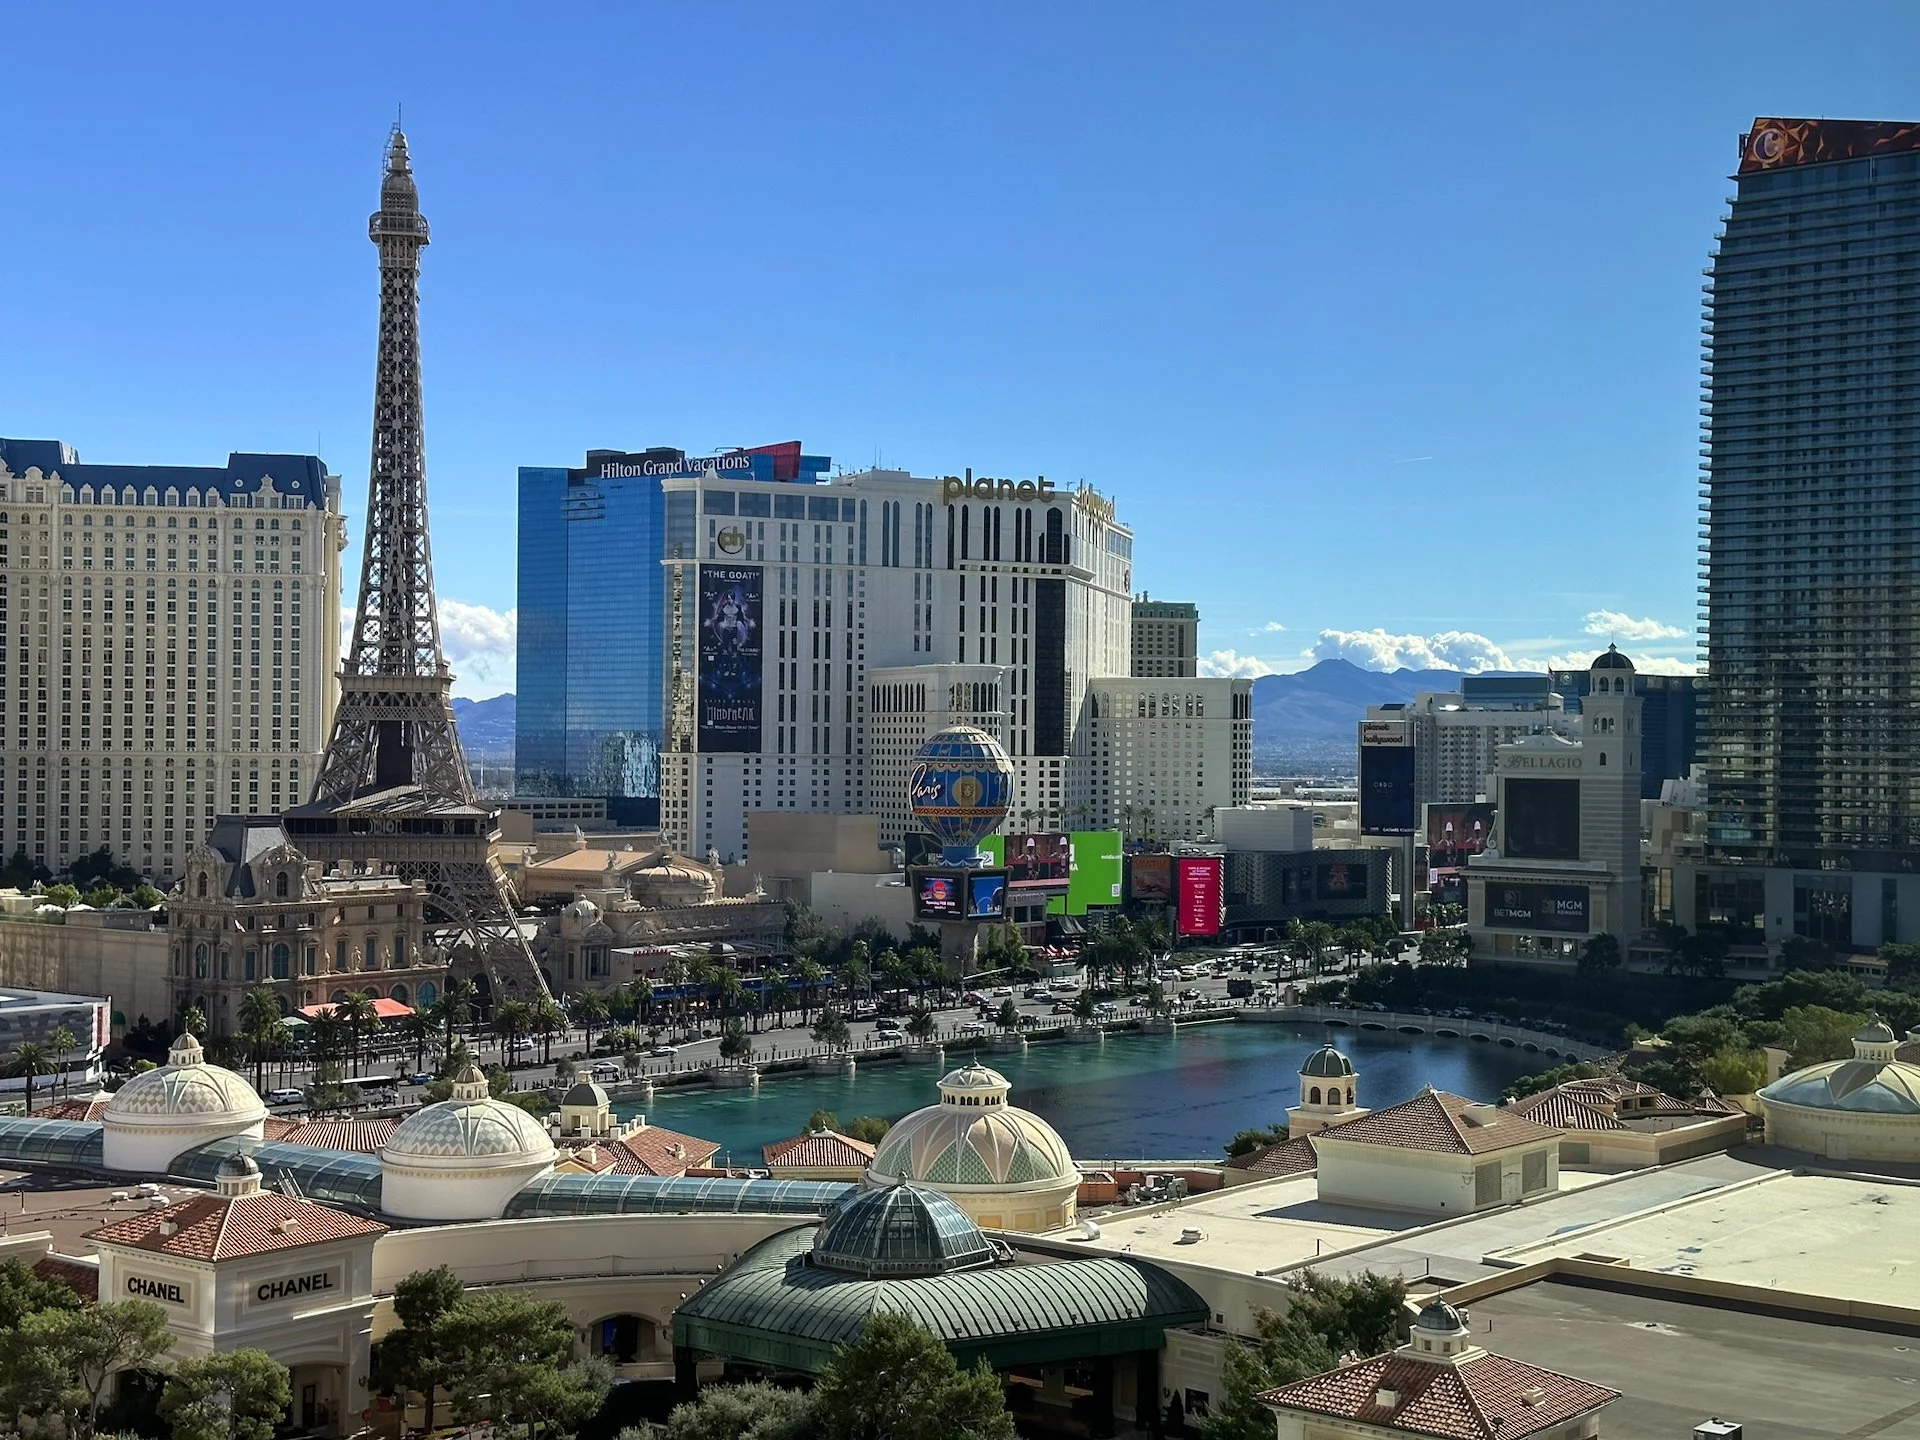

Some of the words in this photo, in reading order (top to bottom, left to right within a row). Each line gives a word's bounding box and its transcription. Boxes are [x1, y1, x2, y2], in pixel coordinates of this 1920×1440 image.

[601, 463, 640, 479] Hilton
[643, 457, 683, 476] Grand
[685, 455, 750, 473] Vacations
[943, 468, 1056, 506] planet
[720, 526, 745, 549] ph
[706, 706, 755, 721] MINDFREAK
[1363, 723, 1390, 733] planet
[1363, 734, 1403, 744] hollywood
[1503, 755, 1583, 769] BELLAGIO
[909, 763, 941, 811] Paris
[1493, 908, 1532, 918] BETMGM
[1557, 900, 1583, 910] MGM
[127, 1277, 184, 1303] CHANEL
[257, 1273, 333, 1300] CHANEL
